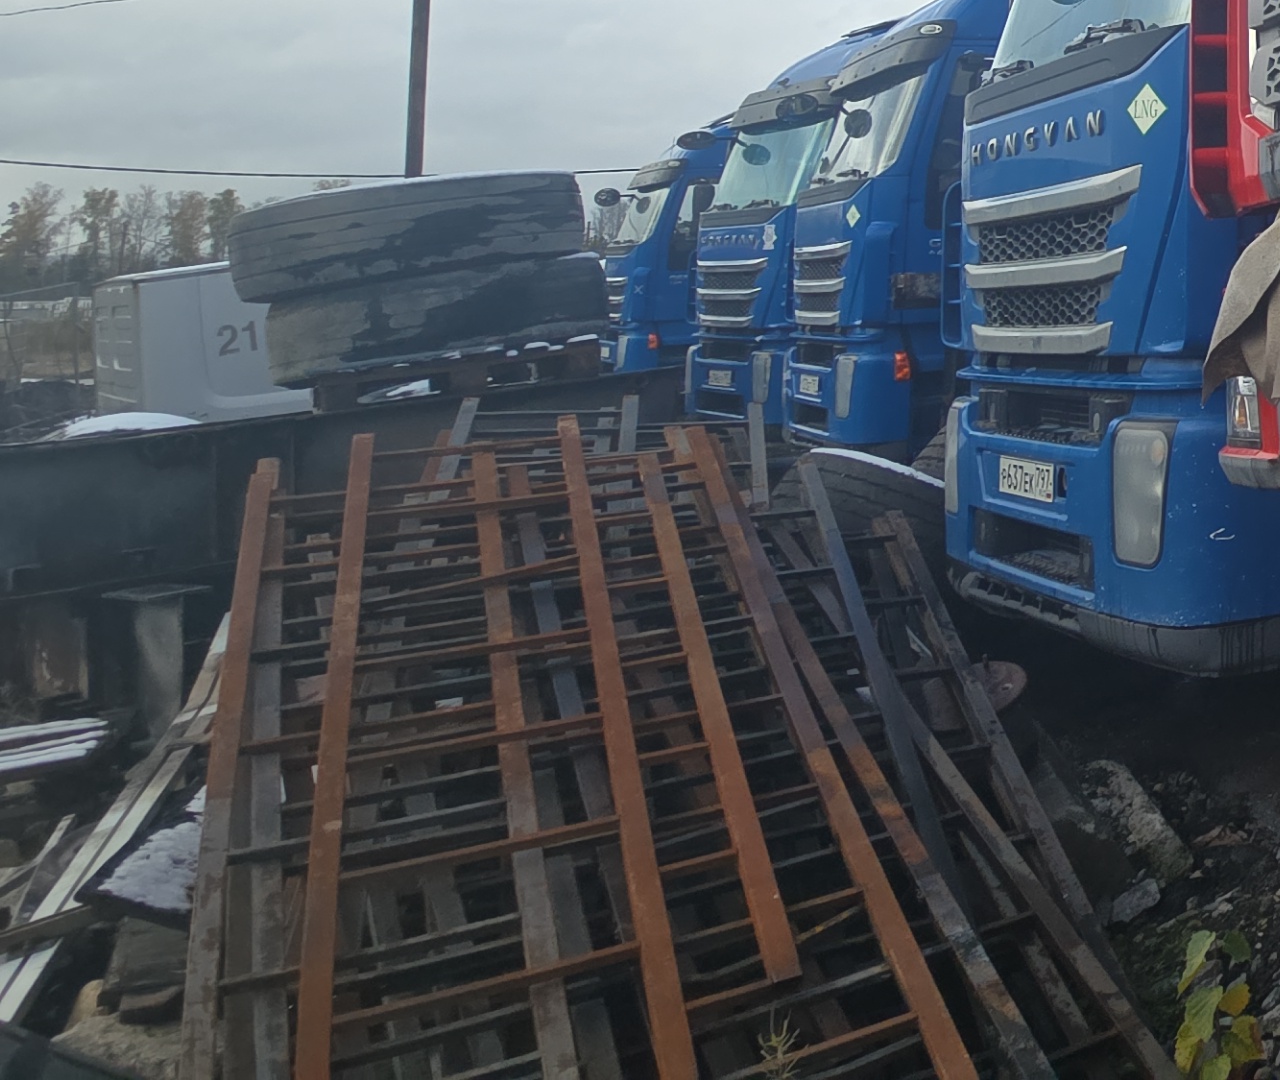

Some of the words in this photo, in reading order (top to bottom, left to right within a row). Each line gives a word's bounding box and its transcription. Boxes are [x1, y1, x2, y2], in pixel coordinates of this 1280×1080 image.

[1133, 96, 1159, 120] LNG
[970, 108, 1105, 166] HONGYAN
[216, 321, 259, 357] 21
